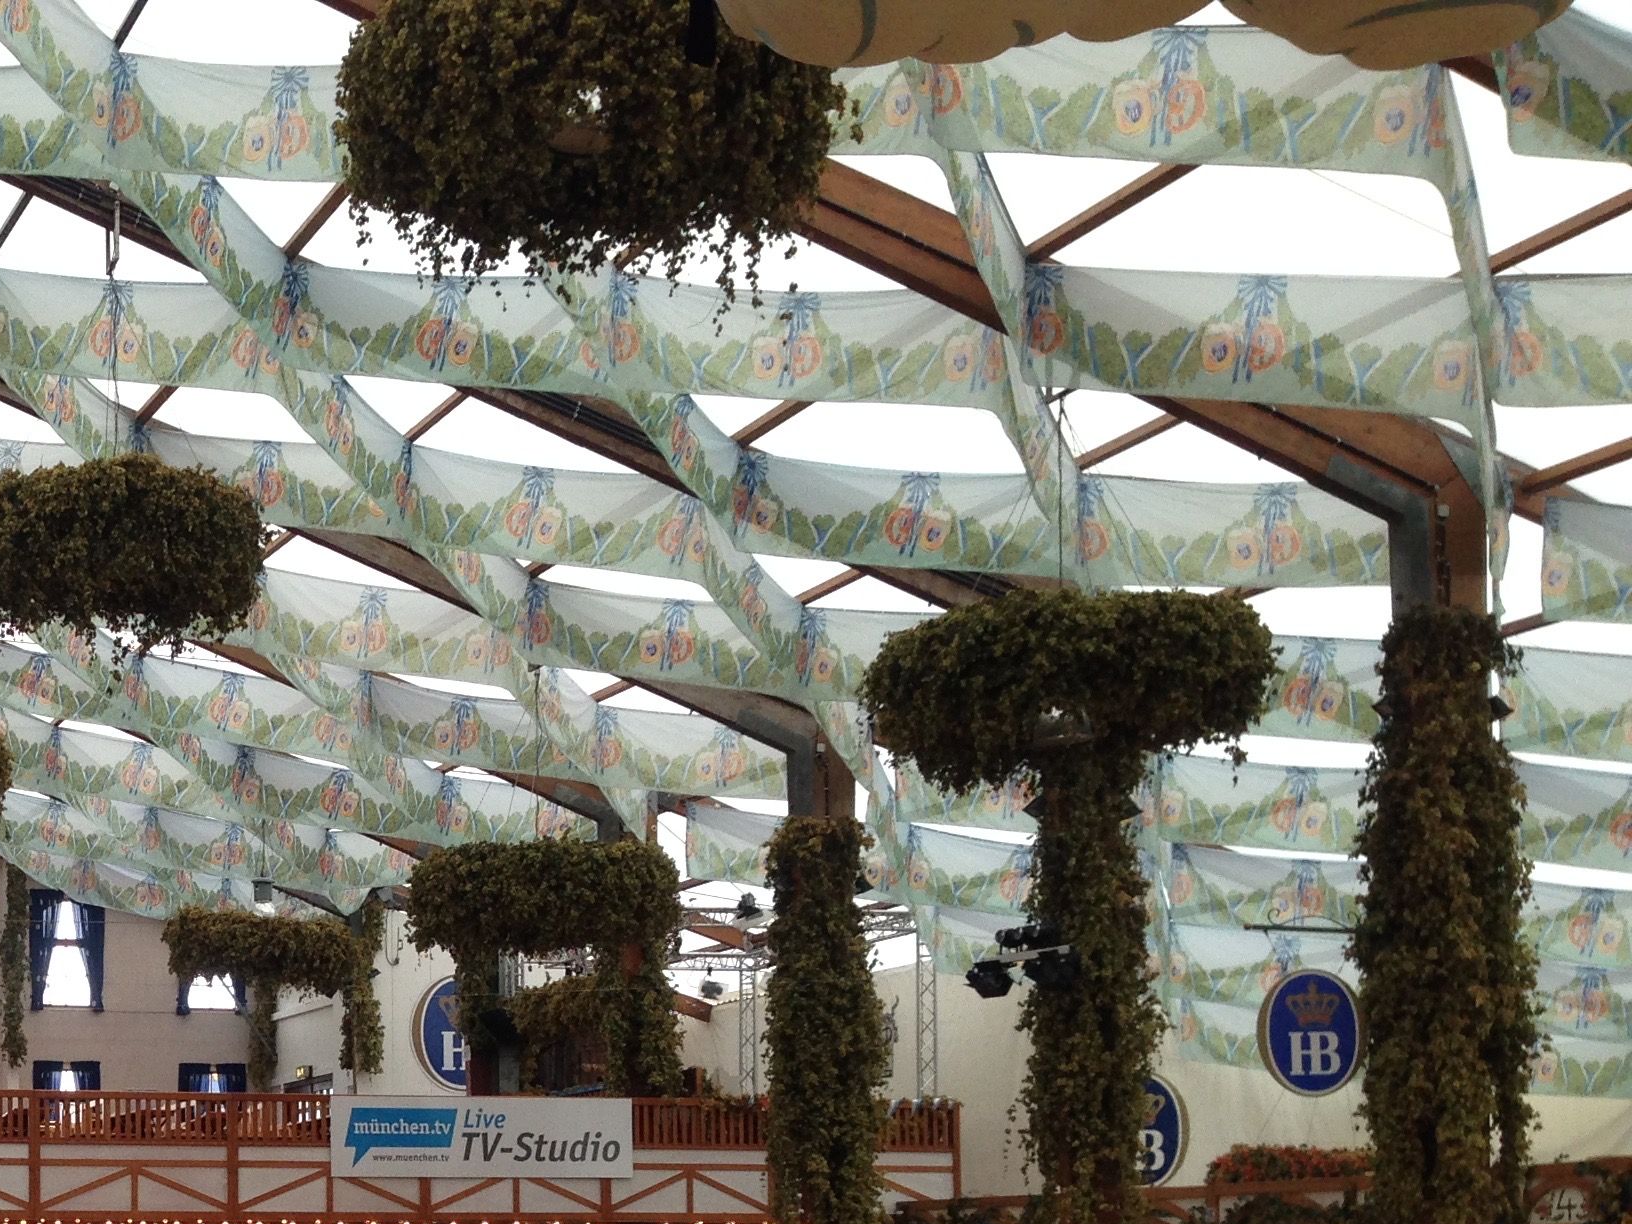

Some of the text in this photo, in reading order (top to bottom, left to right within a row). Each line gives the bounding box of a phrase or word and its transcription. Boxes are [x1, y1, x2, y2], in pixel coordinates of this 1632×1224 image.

[440, 1030, 467, 1071] H
[1288, 1030, 1342, 1076] HB
[353, 1118, 452, 1136] münchen.tv
[463, 1108, 507, 1129] Live
[372, 1152, 450, 1163] www.muenchen.tv
[461, 1130, 621, 1163] TV-Studio
[1134, 1128, 1166, 1171] B
